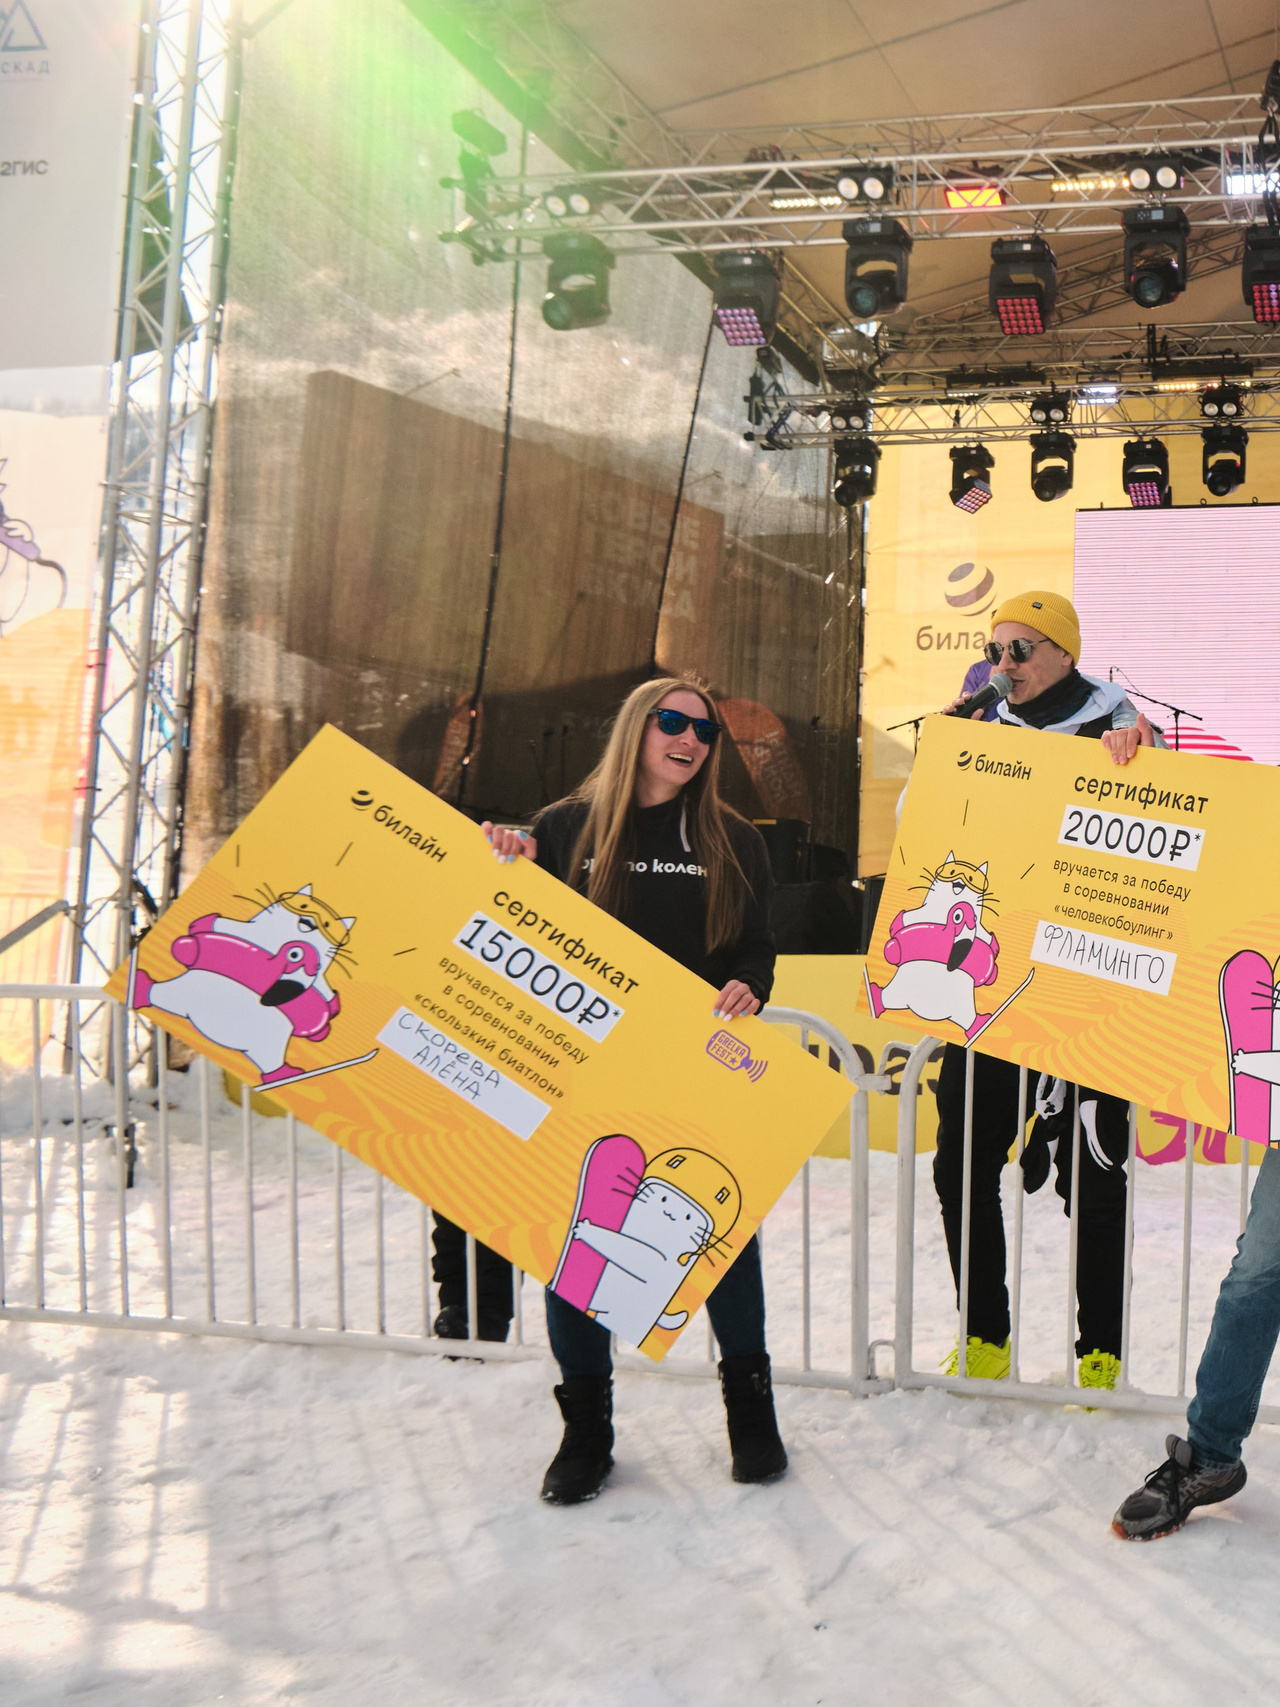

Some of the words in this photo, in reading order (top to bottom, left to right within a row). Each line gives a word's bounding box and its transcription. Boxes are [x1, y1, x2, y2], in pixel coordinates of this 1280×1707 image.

[0, 60, 51, 75] СКАД
[0, 160, 49, 176] 2ГИС
[916, 625, 986, 651] била
[975, 753, 1032, 781] билайн
[1074, 776, 1209, 814] сертификат
[373, 804, 448, 863] билайн
[652, 858, 709, 878] колен
[1053, 859, 1119, 883] вручается
[1122, 874, 1137, 887] за
[1140, 878, 1192, 902] победу
[1063, 882, 1071, 893] в
[1074, 885, 1170, 916] соревновании
[1054, 905, 1173, 940] «человекобоулинг»
[493, 891, 640, 994] сертификат
[1044, 925, 1165, 984] ФЛАМИНГО
[439, 957, 515, 1012] вручается
[516, 1009, 534, 1026] за
[535, 1022, 590, 1064] победу
[442, 985, 452, 996] в
[456, 993, 560, 1068] соревновании
[414, 993, 496, 1052] «скользкий
[498, 1048, 565, 1099] биатлон»
[710, 1042, 732, 1061] FEST
[717, 1033, 747, 1058] GRELKA
